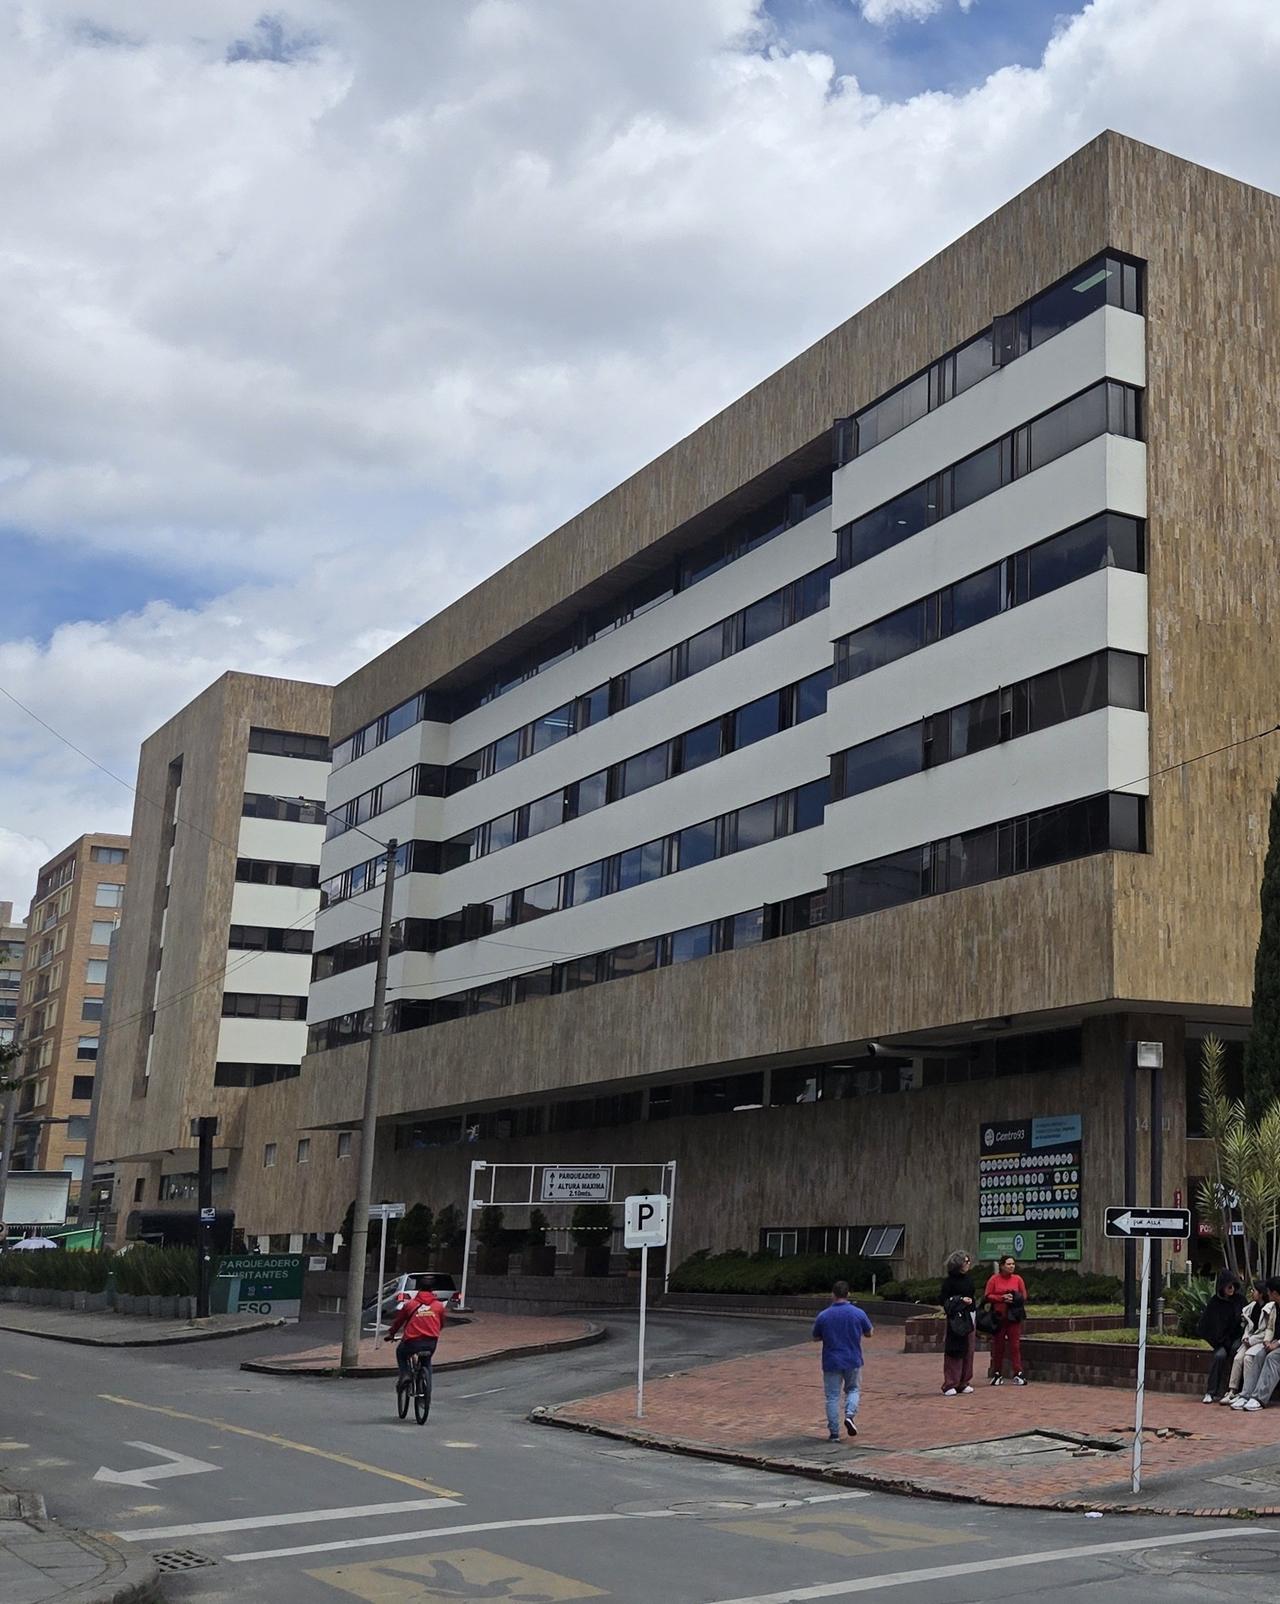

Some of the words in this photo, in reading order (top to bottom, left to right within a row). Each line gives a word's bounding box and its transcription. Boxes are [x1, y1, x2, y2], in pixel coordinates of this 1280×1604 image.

[558, 1172, 601, 1180] PARQUEADERO
[638, 1203, 654, 1230] P
[219, 1258, 300, 1270] PARQUEADERO
